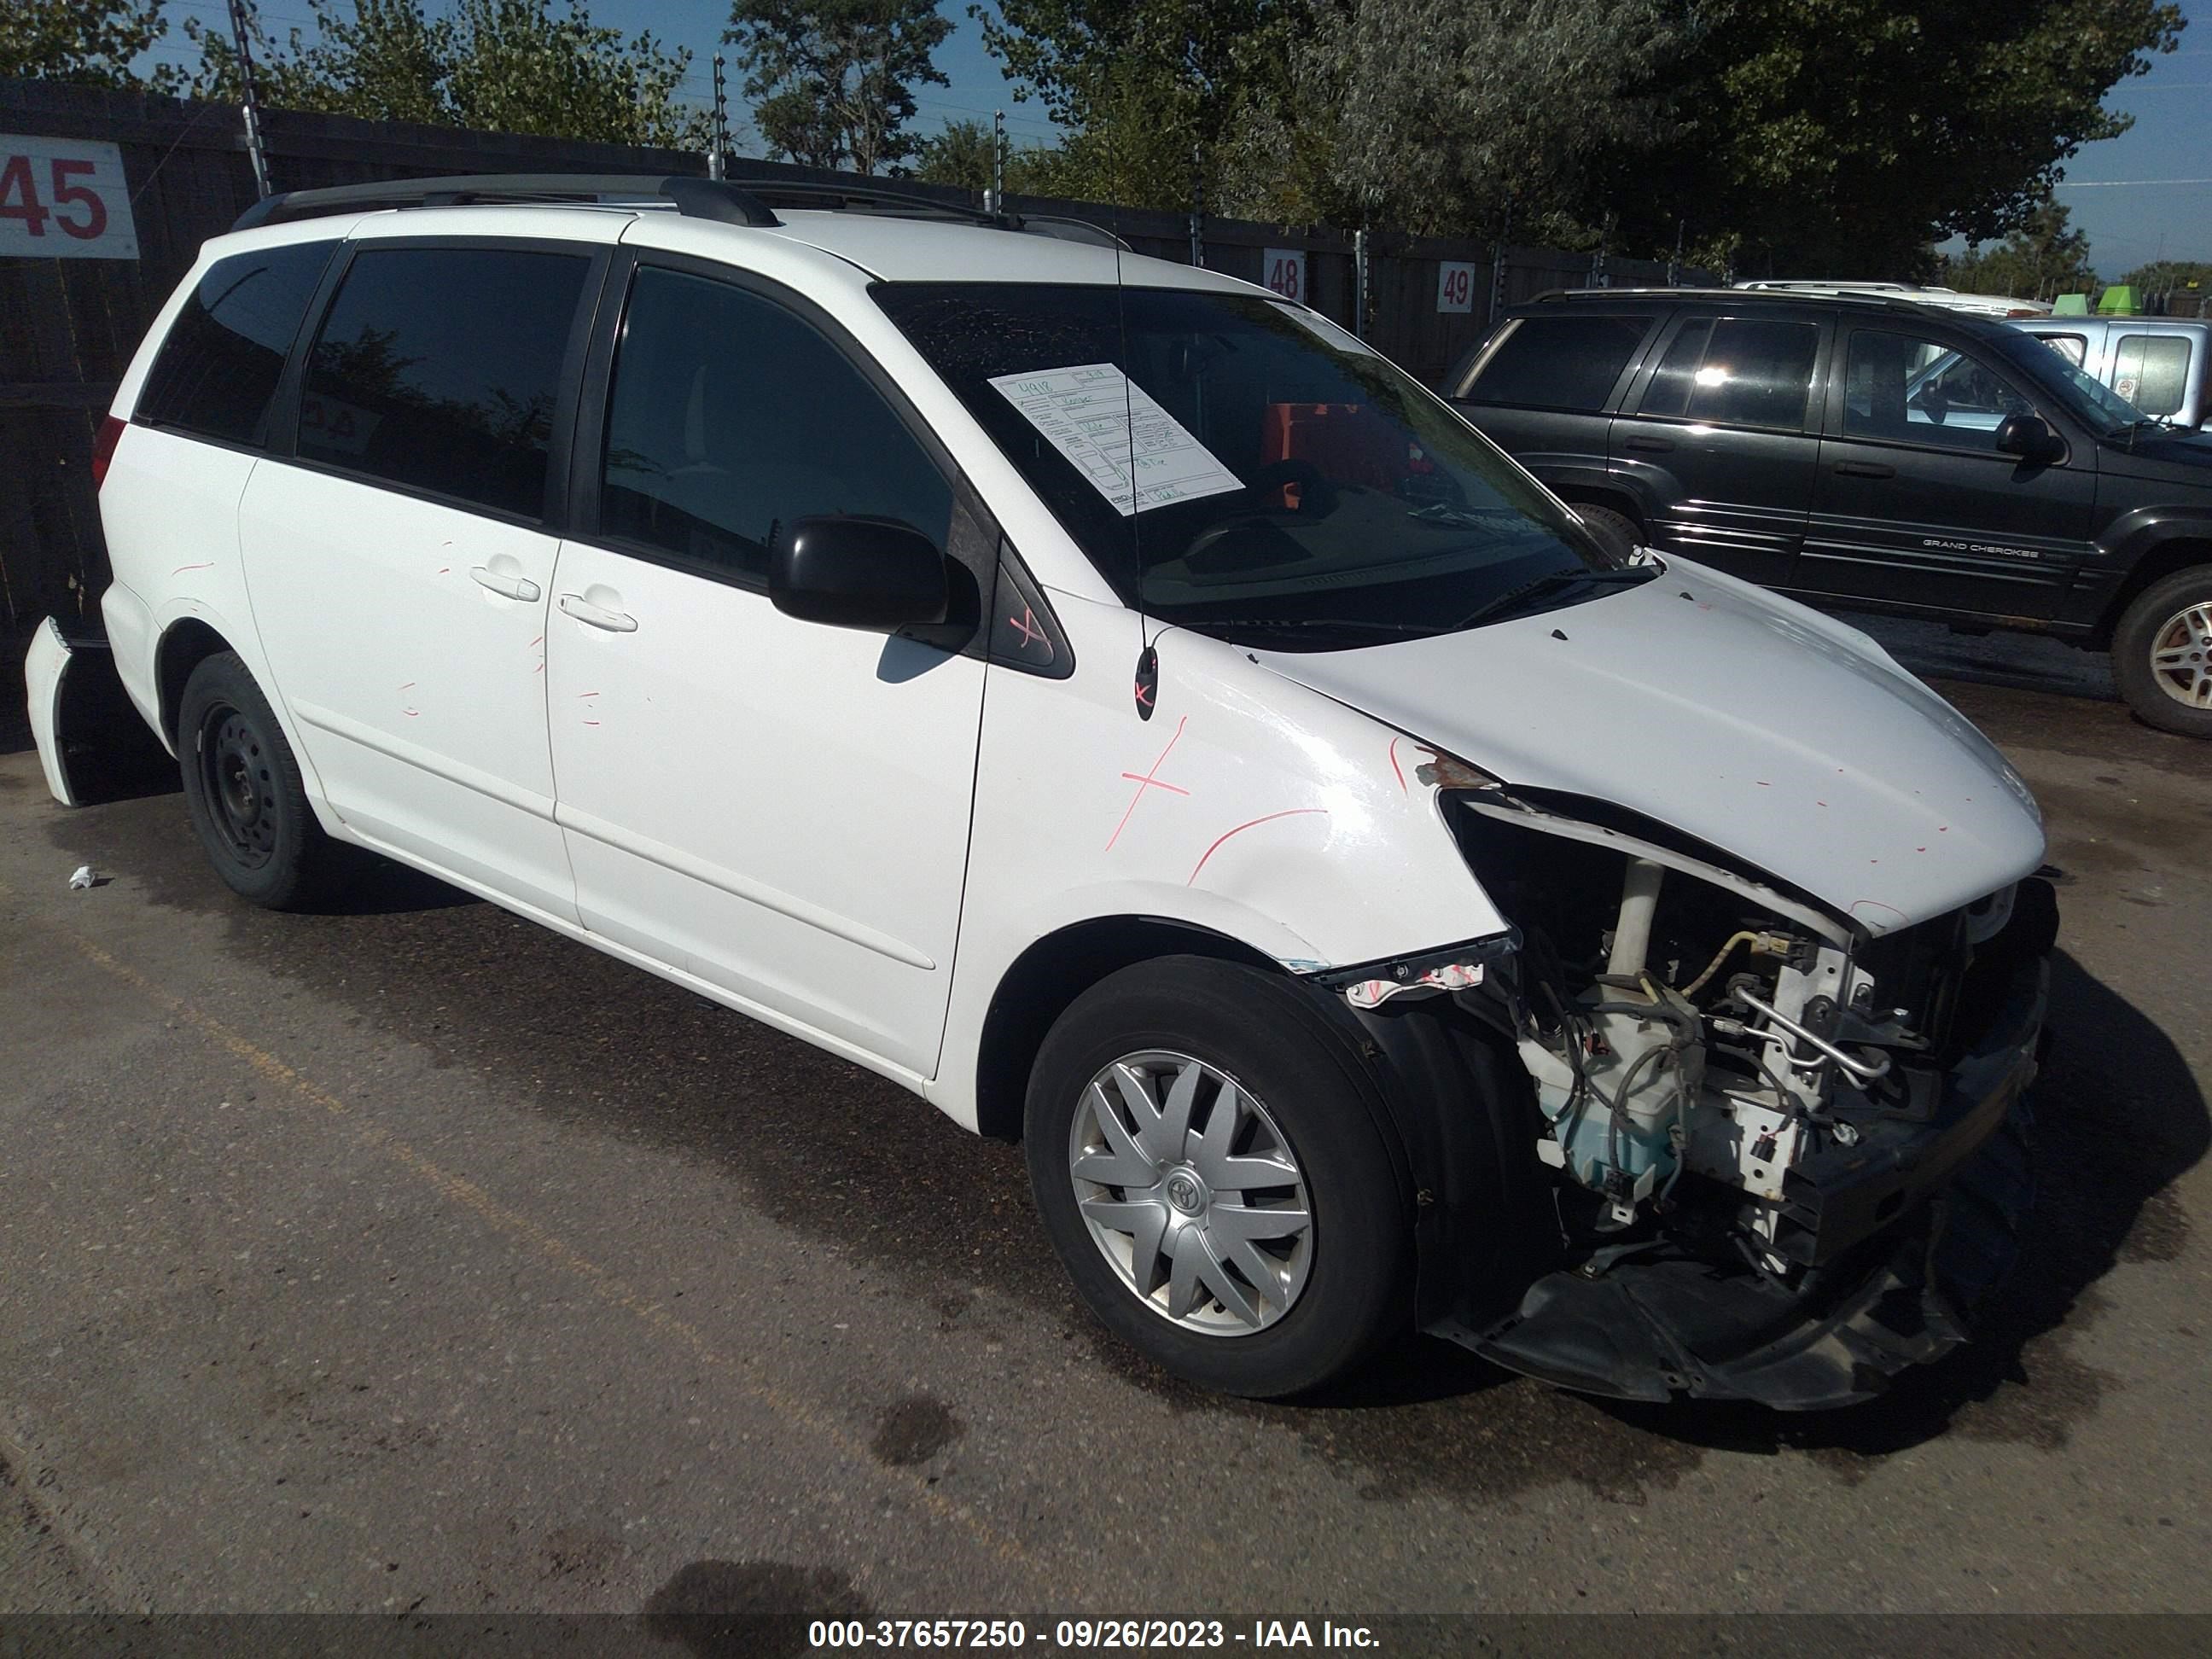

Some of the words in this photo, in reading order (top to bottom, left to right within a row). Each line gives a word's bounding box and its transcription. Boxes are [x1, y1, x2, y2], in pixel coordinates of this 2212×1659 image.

[0, 155, 108, 240] 45
[1270, 259, 1298, 299] 48
[1443, 270, 1469, 305] 49
[1923, 539, 1967, 550] GRAND
[1970, 544, 2040, 558] CHEROKEE
